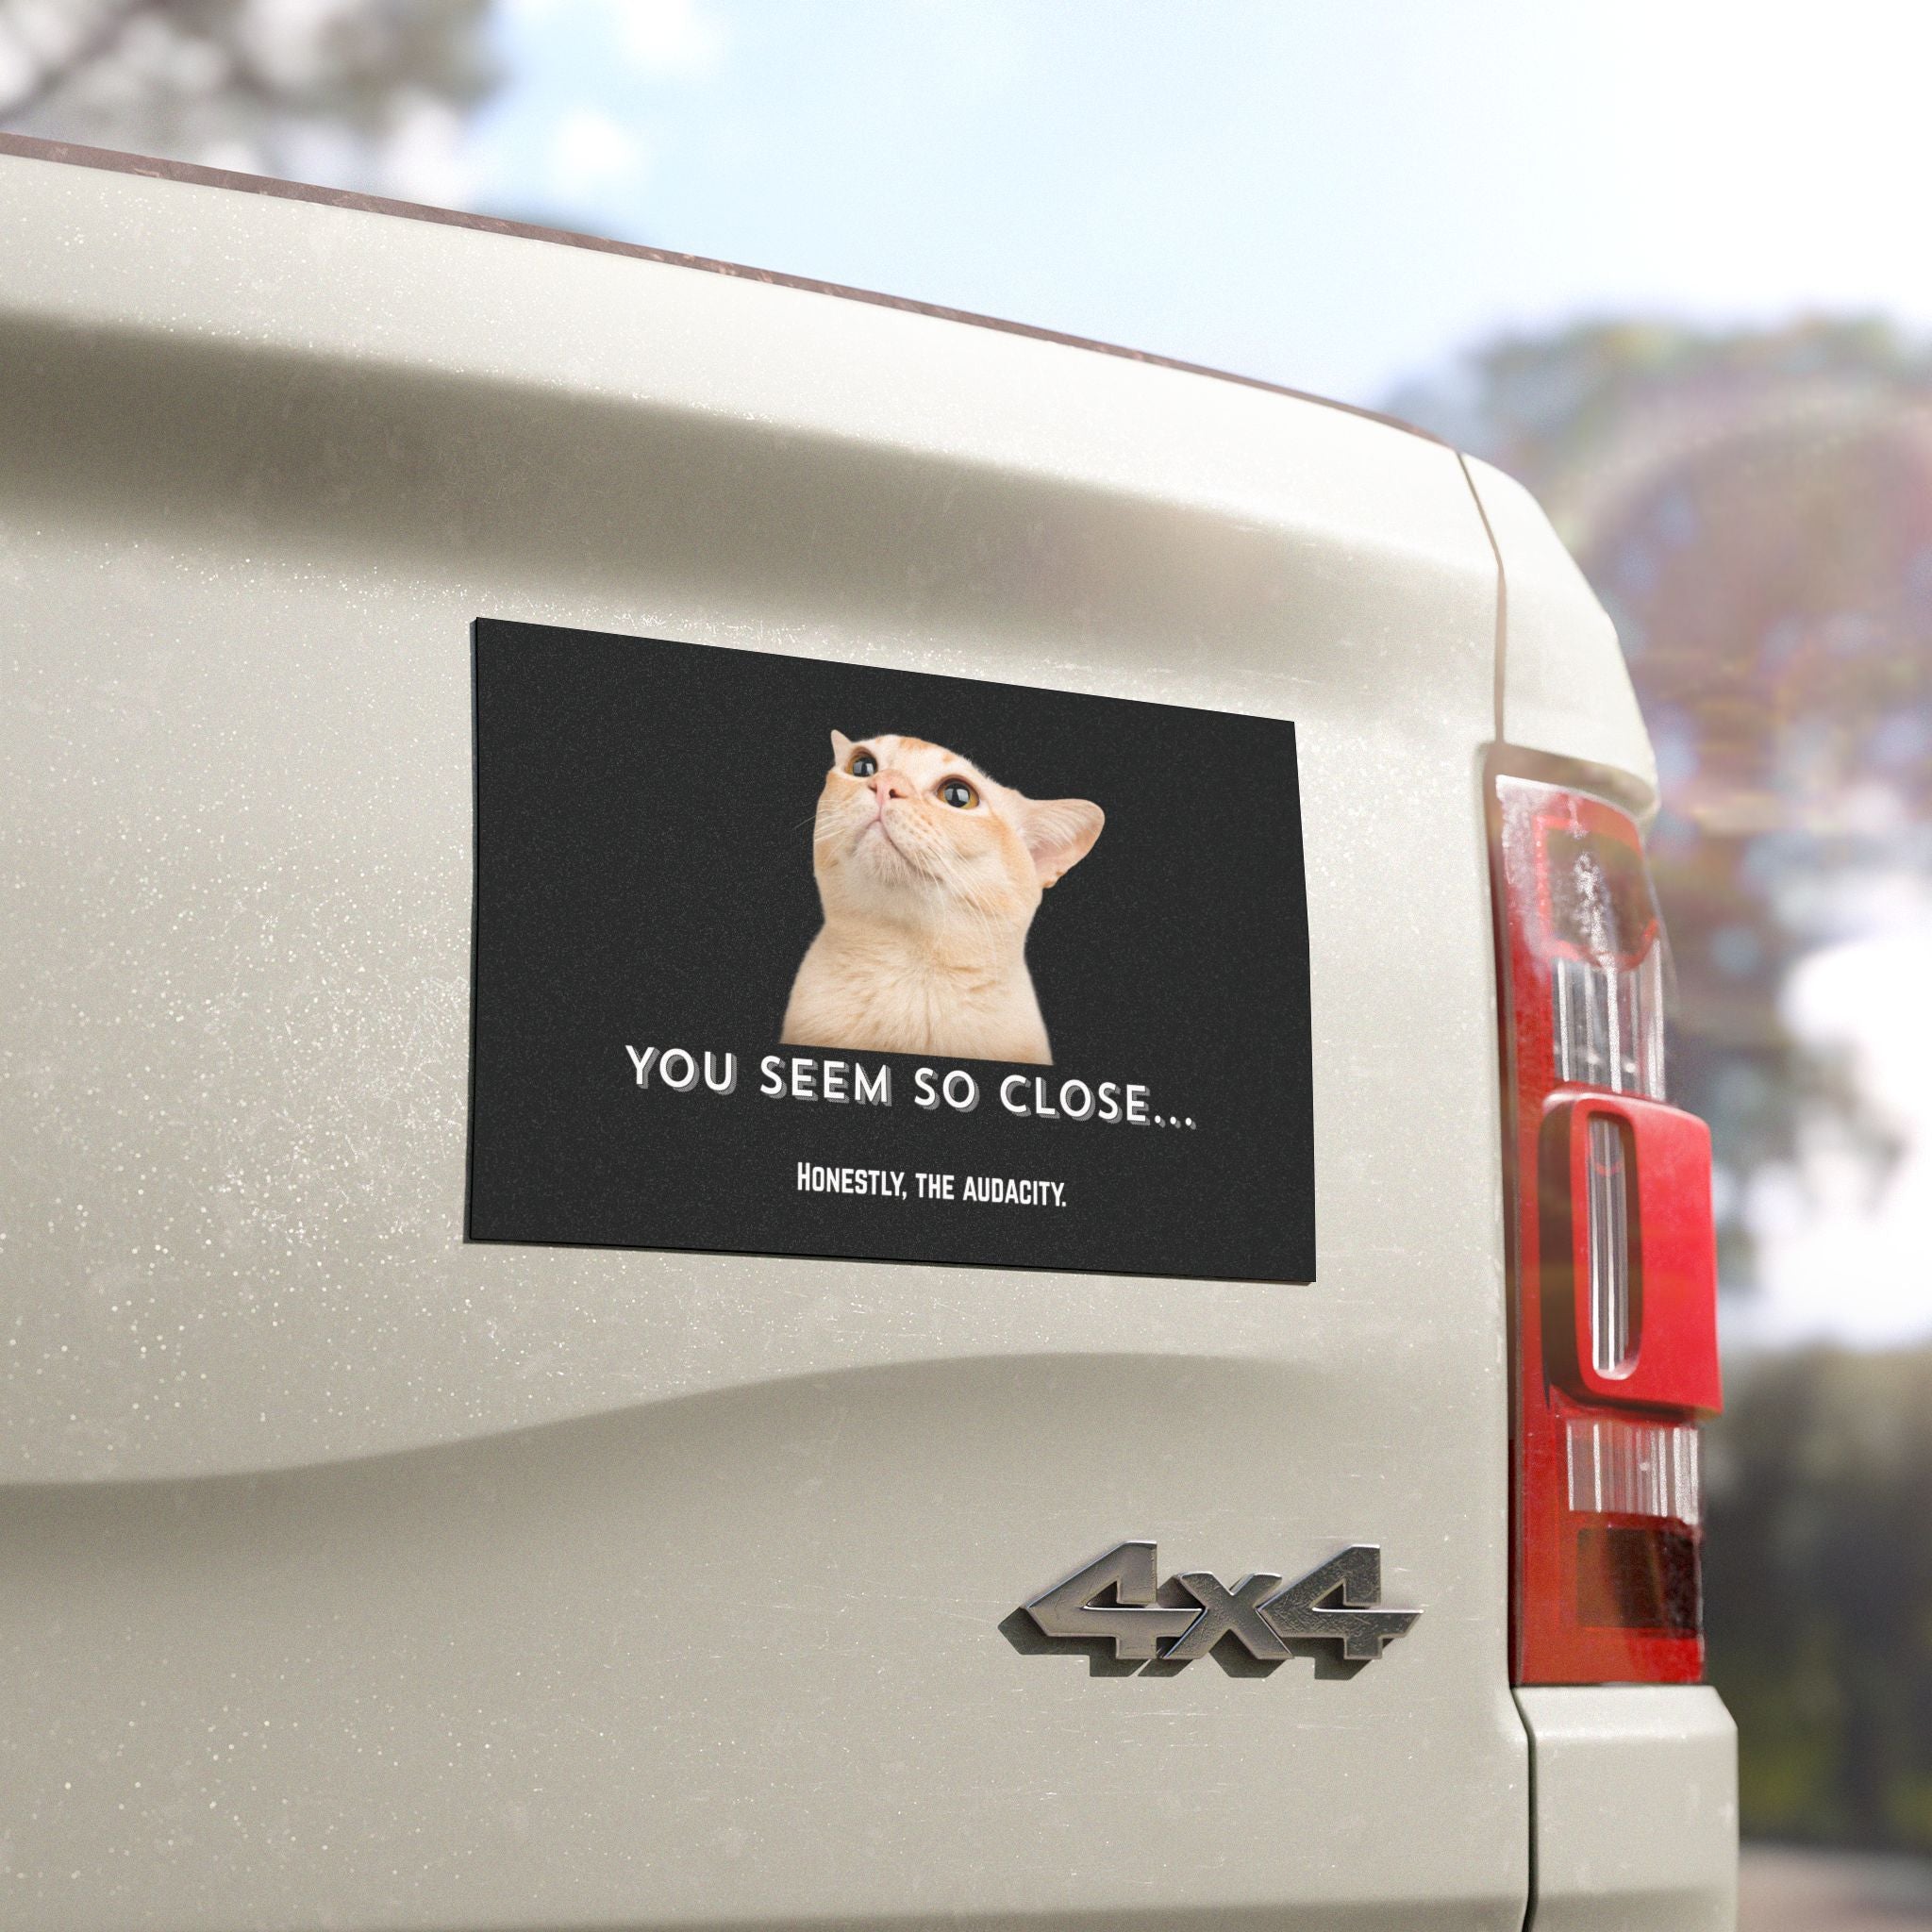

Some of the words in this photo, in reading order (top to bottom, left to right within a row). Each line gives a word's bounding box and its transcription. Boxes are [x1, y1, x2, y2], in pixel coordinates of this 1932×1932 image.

[625, 1044, 738, 1095] YOU
[760, 1055, 892, 1107] SEEM
[914, 1067, 980, 1113] SO
[1000, 1074, 1197, 1130] CLOSE...
[914, 1172, 956, 1201] THE
[962, 1175, 1067, 1208] AUDACITY.
[1025, 1540, 1424, 1660] 4x4
